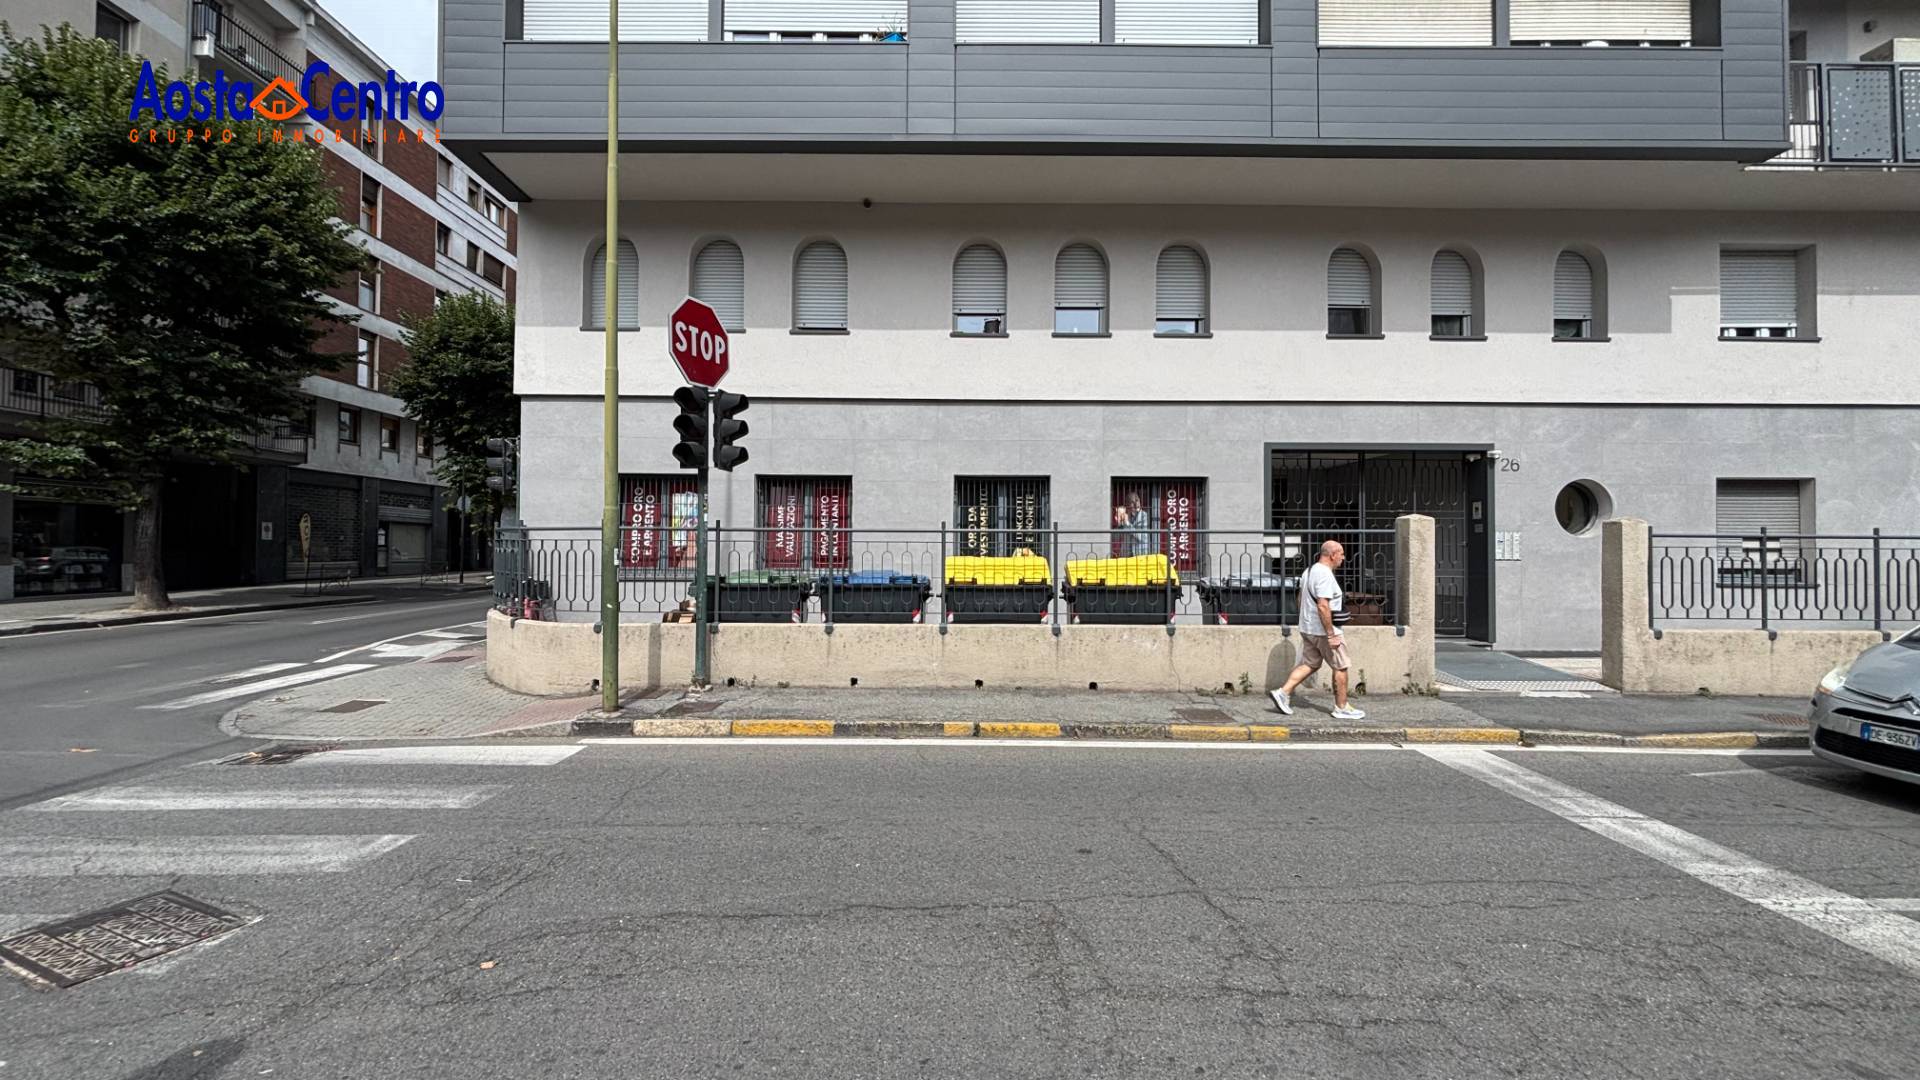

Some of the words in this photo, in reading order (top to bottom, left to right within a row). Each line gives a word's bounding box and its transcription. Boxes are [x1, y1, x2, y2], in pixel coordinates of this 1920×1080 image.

[675, 321, 726, 365] STOP
[1500, 458, 1520, 472] 26
[1167, 490, 1177, 515] ORO
[820, 495, 830, 556] PAGAMENTO
